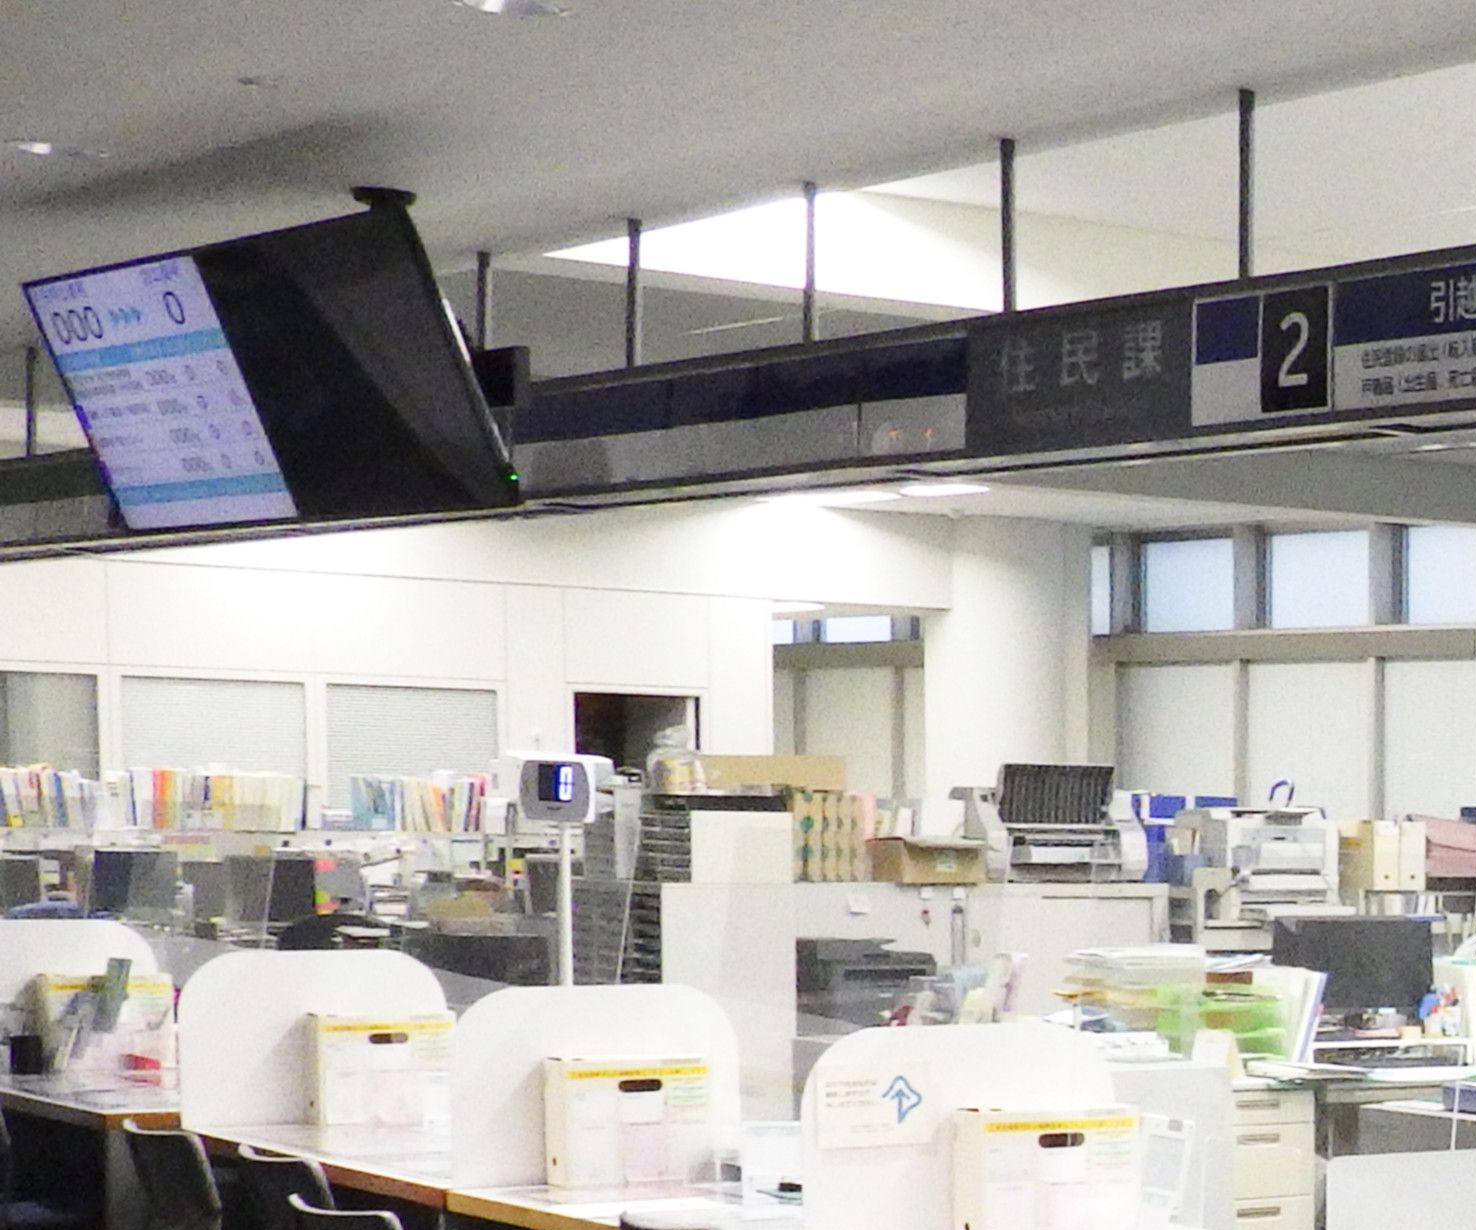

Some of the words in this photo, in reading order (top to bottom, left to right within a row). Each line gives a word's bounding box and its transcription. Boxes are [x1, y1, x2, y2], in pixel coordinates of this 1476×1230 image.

[164, 291, 185, 325] 0
[997, 321, 1163, 393] 住民課
[1276, 311, 1310, 388] 2
